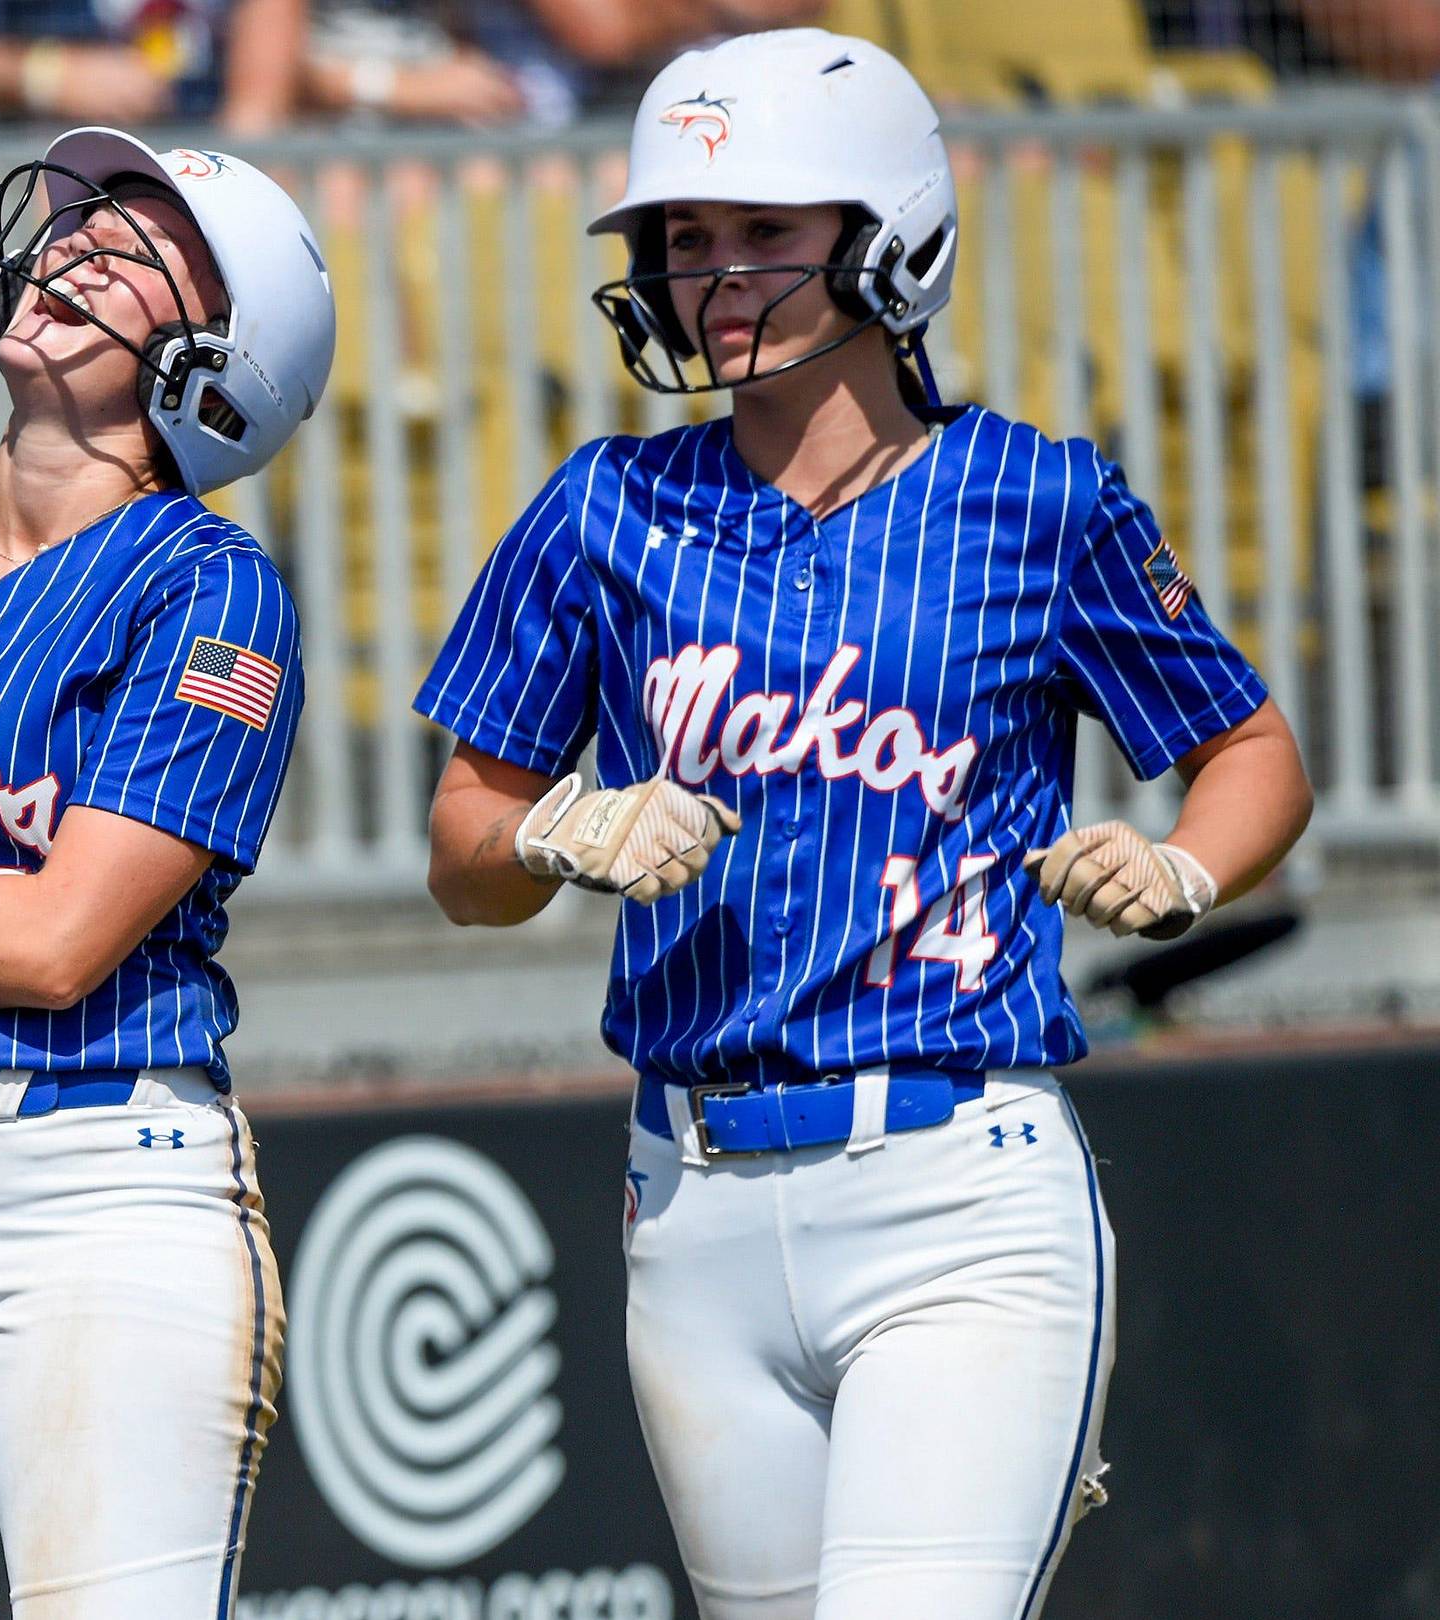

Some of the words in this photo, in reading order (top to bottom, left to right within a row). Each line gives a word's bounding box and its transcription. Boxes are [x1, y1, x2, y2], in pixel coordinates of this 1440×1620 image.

[243, 350, 283, 407] EVOSHIELD
[643, 643, 978, 824] Makos
[864, 855, 998, 992] 14
